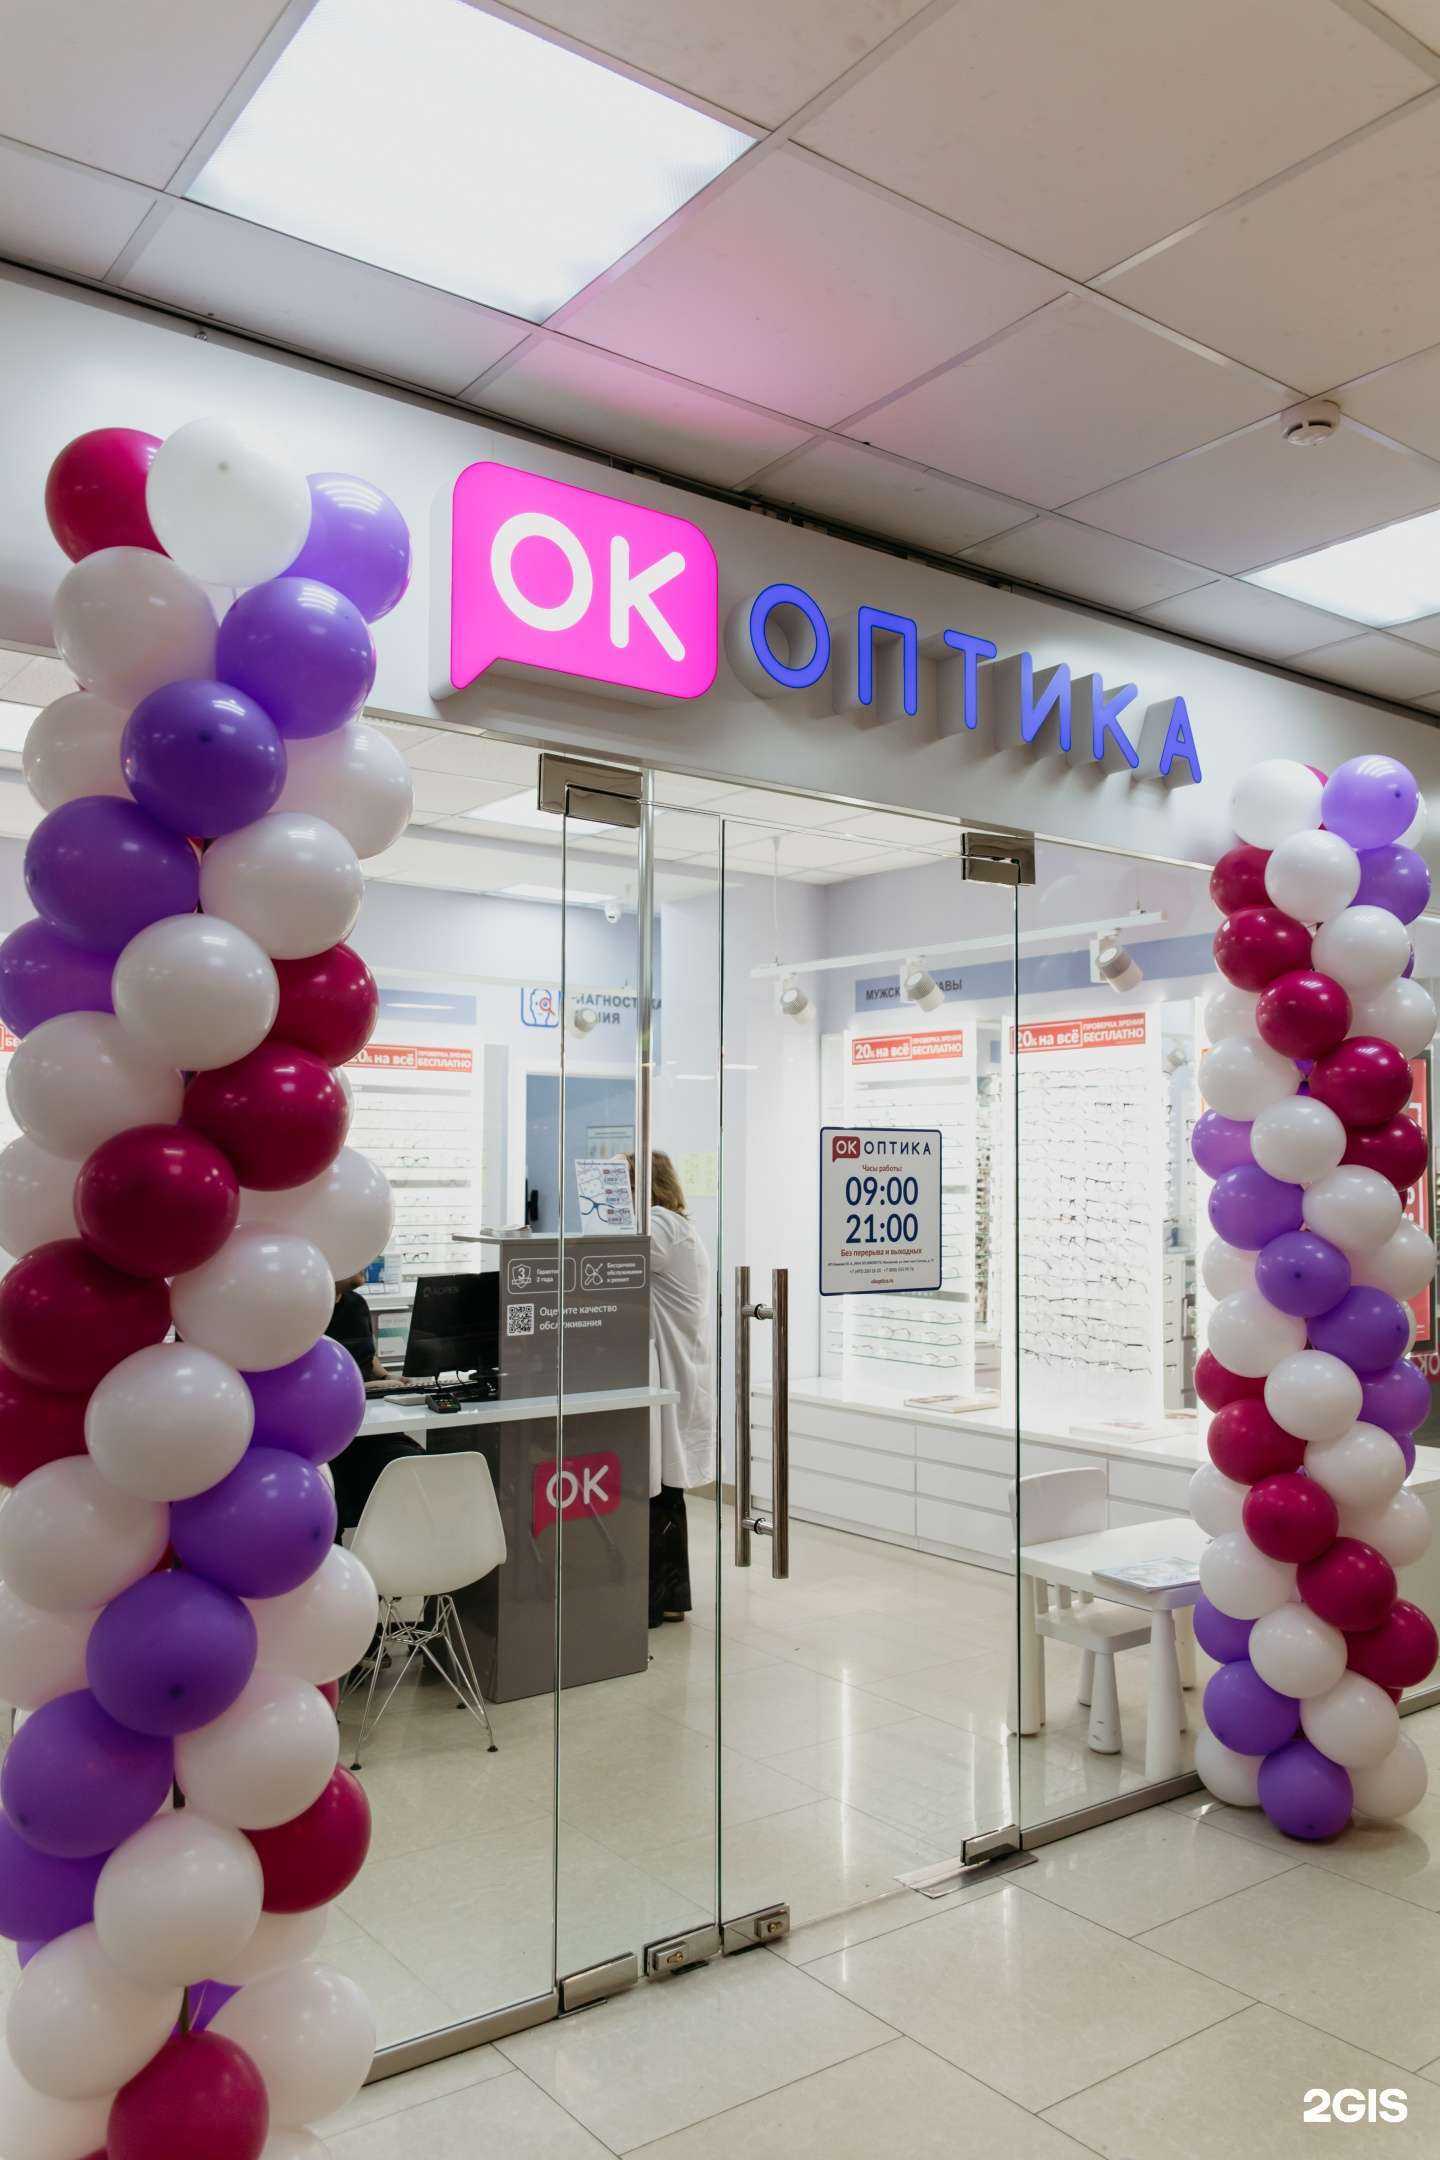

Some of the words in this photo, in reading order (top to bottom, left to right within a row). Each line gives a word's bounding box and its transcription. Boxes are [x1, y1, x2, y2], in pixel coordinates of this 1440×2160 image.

[490, 512, 686, 662] ОК
[749, 582, 1204, 785] ОПТИКА
[1039, 1035, 1055, 1046] на
[1057, 1030, 1079, 1045] всё
[1083, 1028, 1144, 1043] БЕСПЛАТНО
[876, 1047, 889, 1057] на
[912, 1043, 962, 1056] БЕСПЛАТНО
[374, 1054, 390, 1064] на
[393, 1053, 414, 1066] всё
[418, 1057, 472, 1069] БЕСПЛАТНО
[836, 1140, 857, 1154] ОК
[864, 1141, 931, 1155] ОПТИКА
[862, 1164, 878, 1173] Часы
[845, 1176, 919, 1206] 09:00
[845, 1213, 919, 1244] 21:00
[840, 1249, 852, 1257] Без
[853, 1250, 884, 1258] перерыва
[891, 1248, 922, 1256] выходных
[540, 1305, 577, 1317] Оцеите
[579, 1304, 618, 1314] качество
[539, 1319, 602, 1331] обслживания
[545, 1464, 609, 1510] ОК
